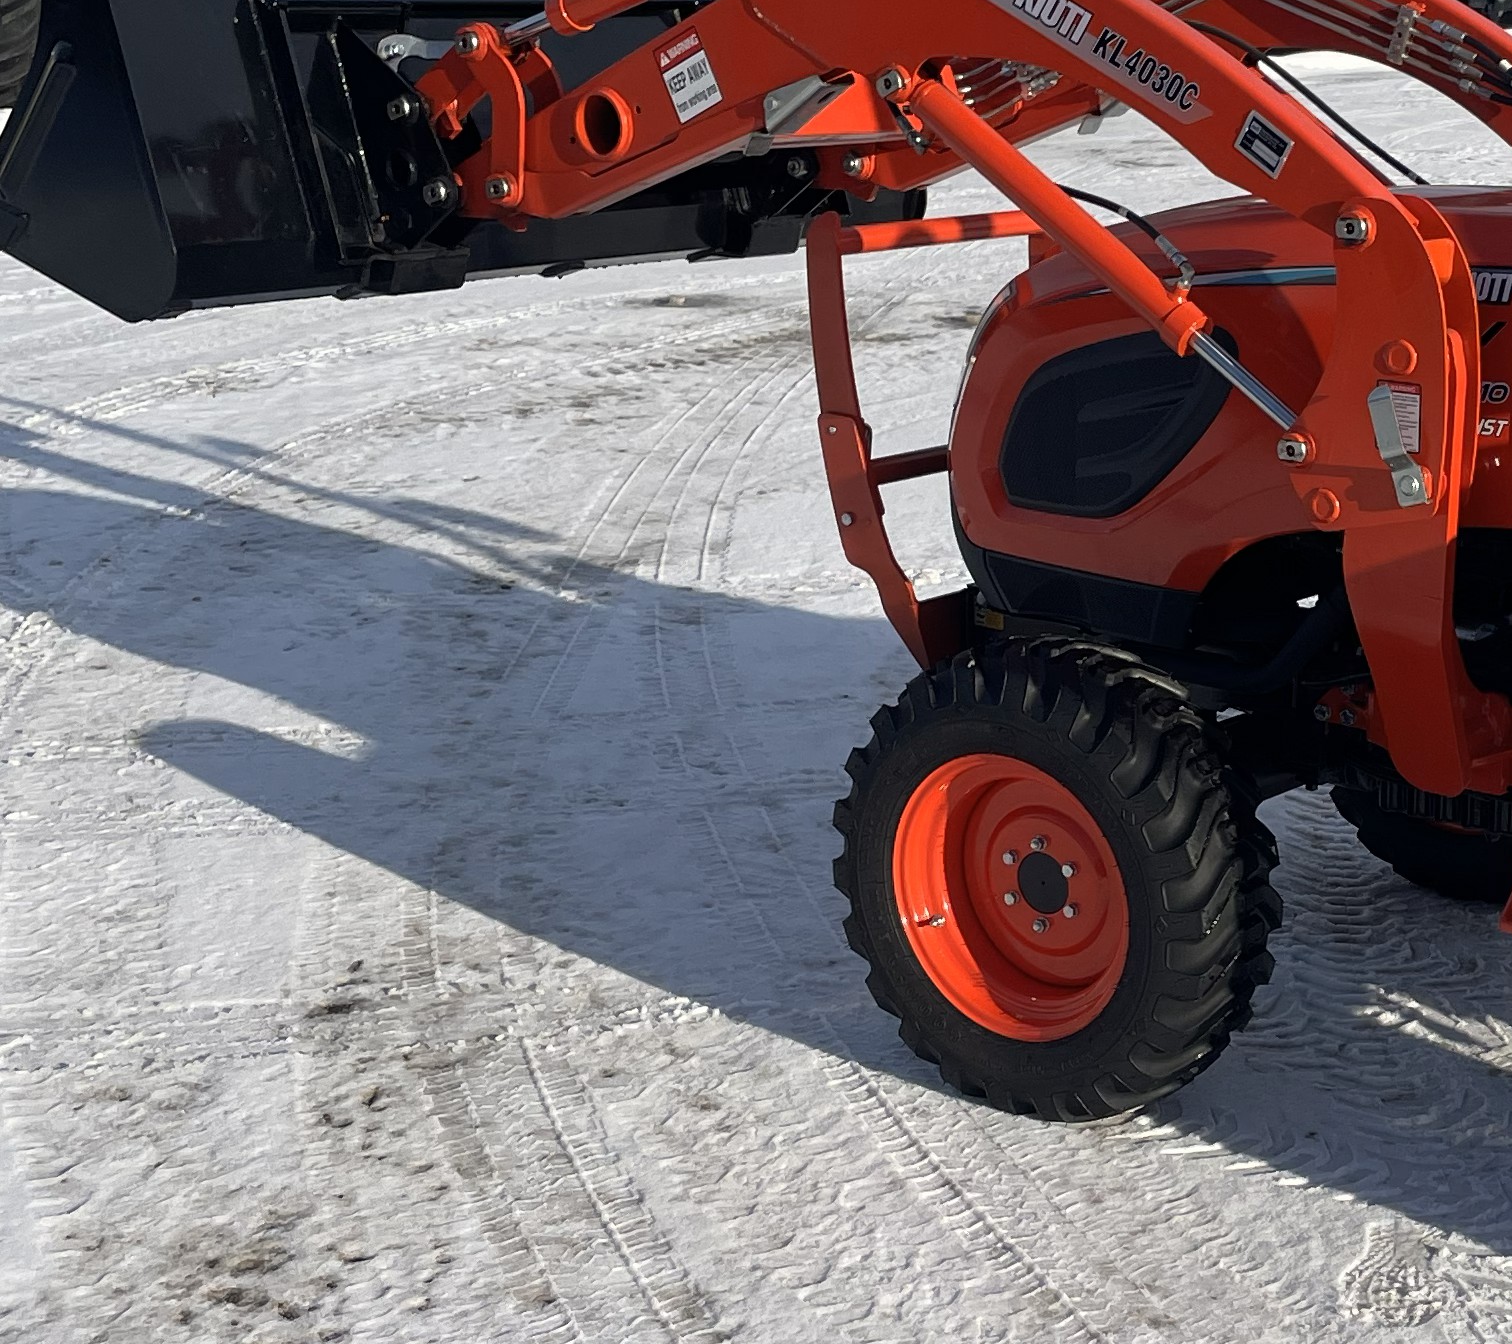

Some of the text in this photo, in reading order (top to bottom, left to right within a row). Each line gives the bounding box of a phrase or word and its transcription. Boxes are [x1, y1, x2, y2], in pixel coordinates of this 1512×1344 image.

[666, 57, 709, 95] KEEP AWAY
[1091, 26, 1201, 112] KL4030C
